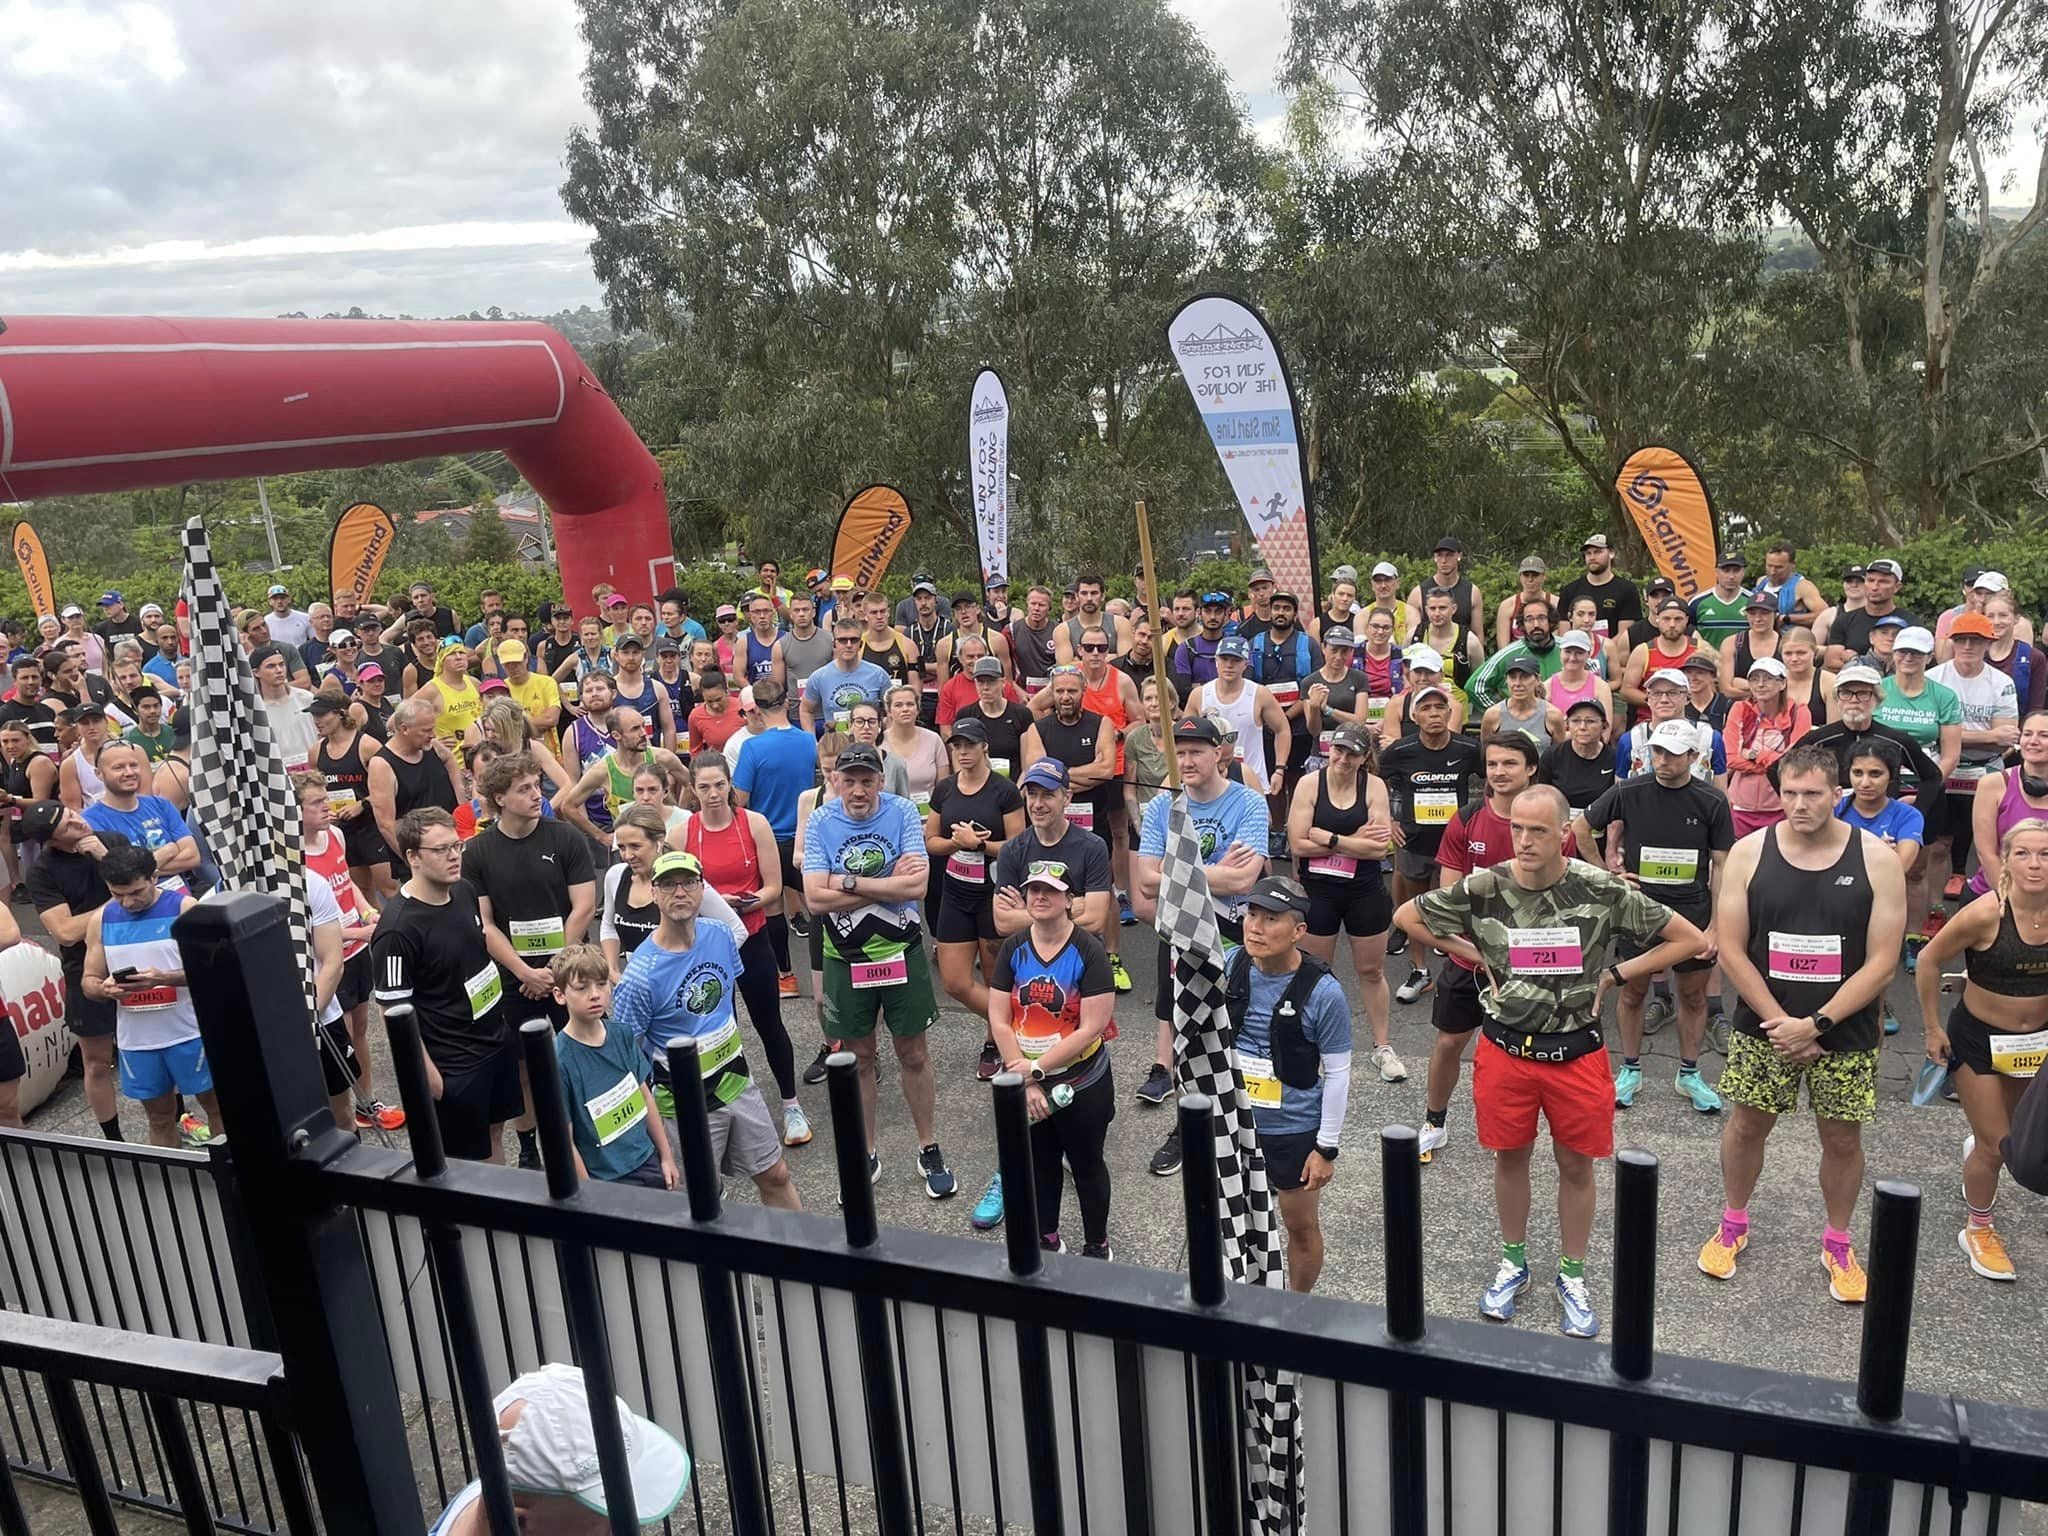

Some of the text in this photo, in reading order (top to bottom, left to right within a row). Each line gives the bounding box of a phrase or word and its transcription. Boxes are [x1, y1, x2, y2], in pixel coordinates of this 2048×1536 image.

[988, 431, 998, 498] YOUNG
[979, 437, 987, 521] RUN FOR
[1882, 706, 1937, 718] RUNNING IN
[1882, 713, 1901, 722] THE
[834, 833, 897, 864] DANDENONGS
[527, 937, 547, 948] 521
[1533, 951, 1556, 964] 721
[1790, 958, 1818, 970] 627
[866, 967, 892, 979] 800
[676, 962, 728, 1009] DANDENONGS
[1029, 982, 1055, 992] RUN
[131, 990, 164, 1003] 2003
[715, 1042, 730, 1061] 577
[1495, 1036, 1564, 1062] naked
[2013, 1055, 2041, 1068] 882
